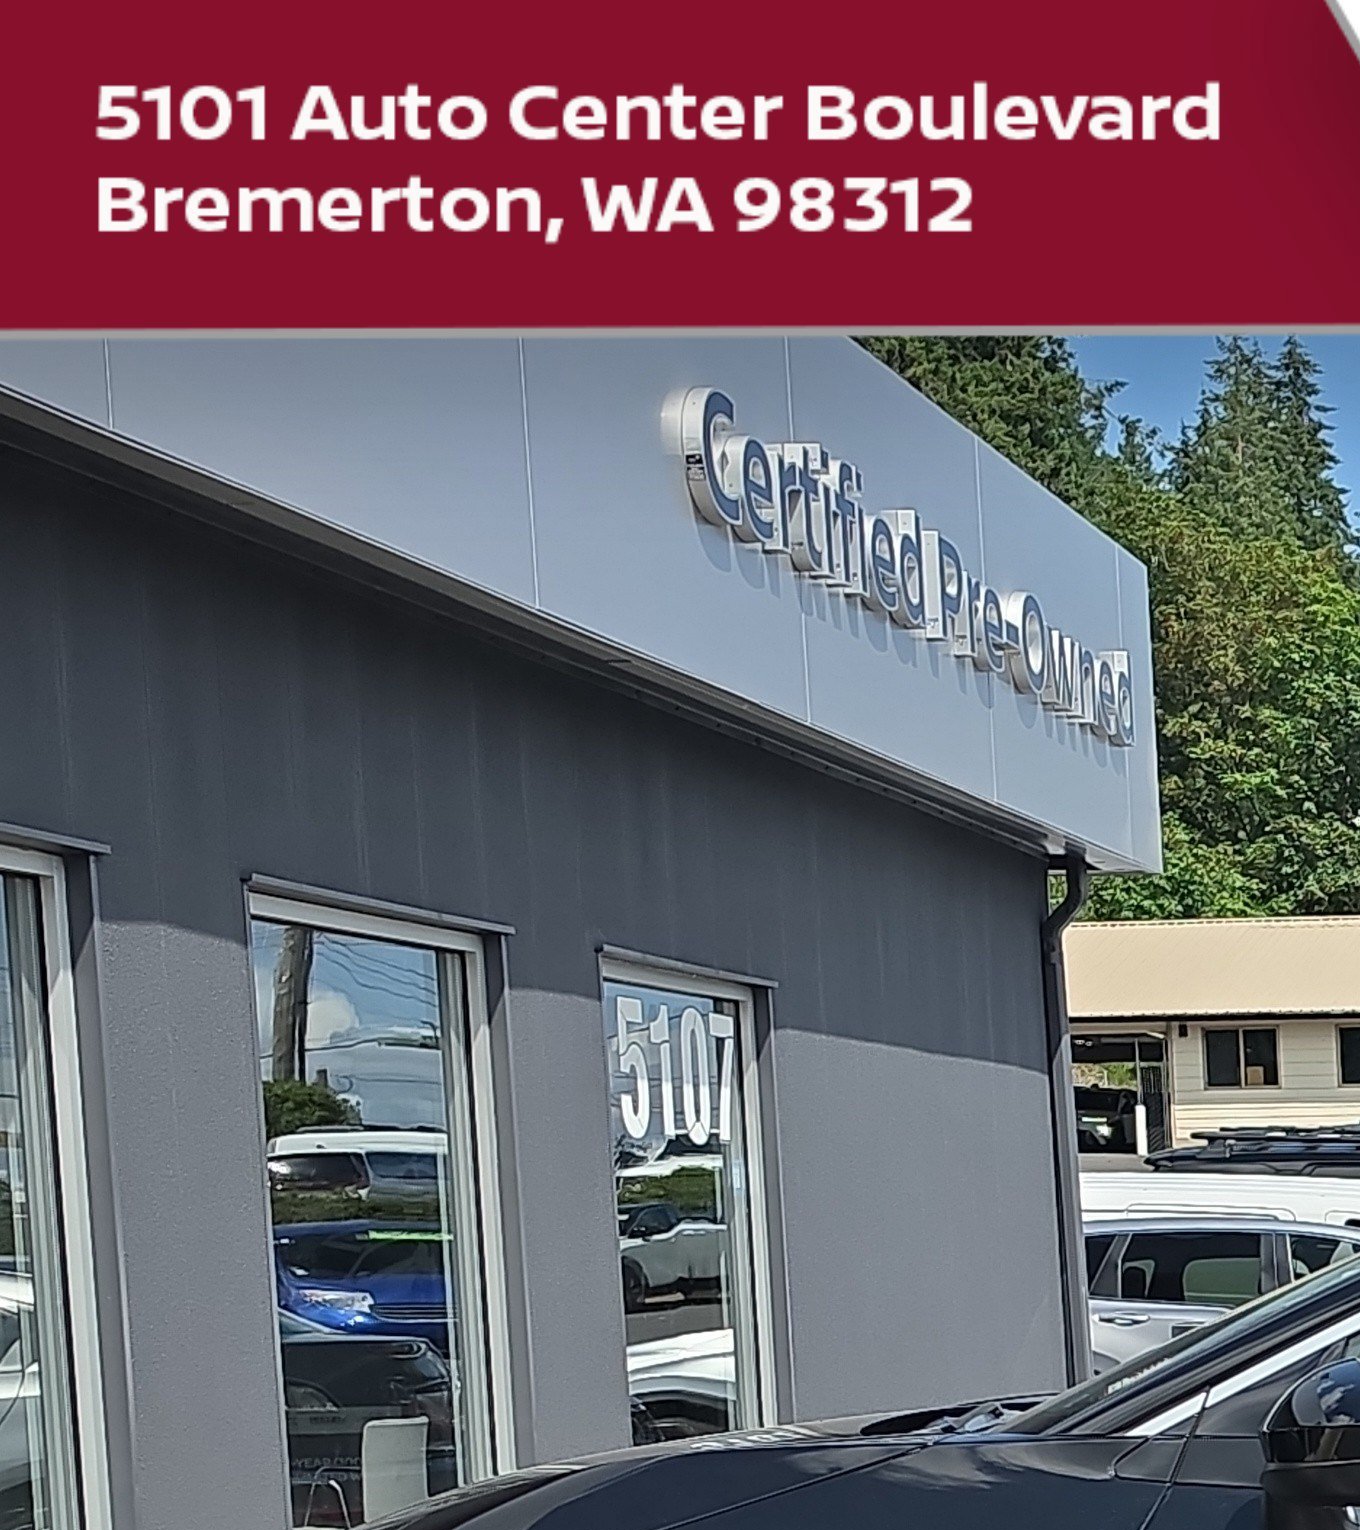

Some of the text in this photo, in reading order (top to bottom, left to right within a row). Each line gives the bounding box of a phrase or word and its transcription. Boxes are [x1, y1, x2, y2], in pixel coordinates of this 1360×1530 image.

[681, 386, 1134, 747] Certified Pre-Owned
[616, 996, 735, 1144] 5107
